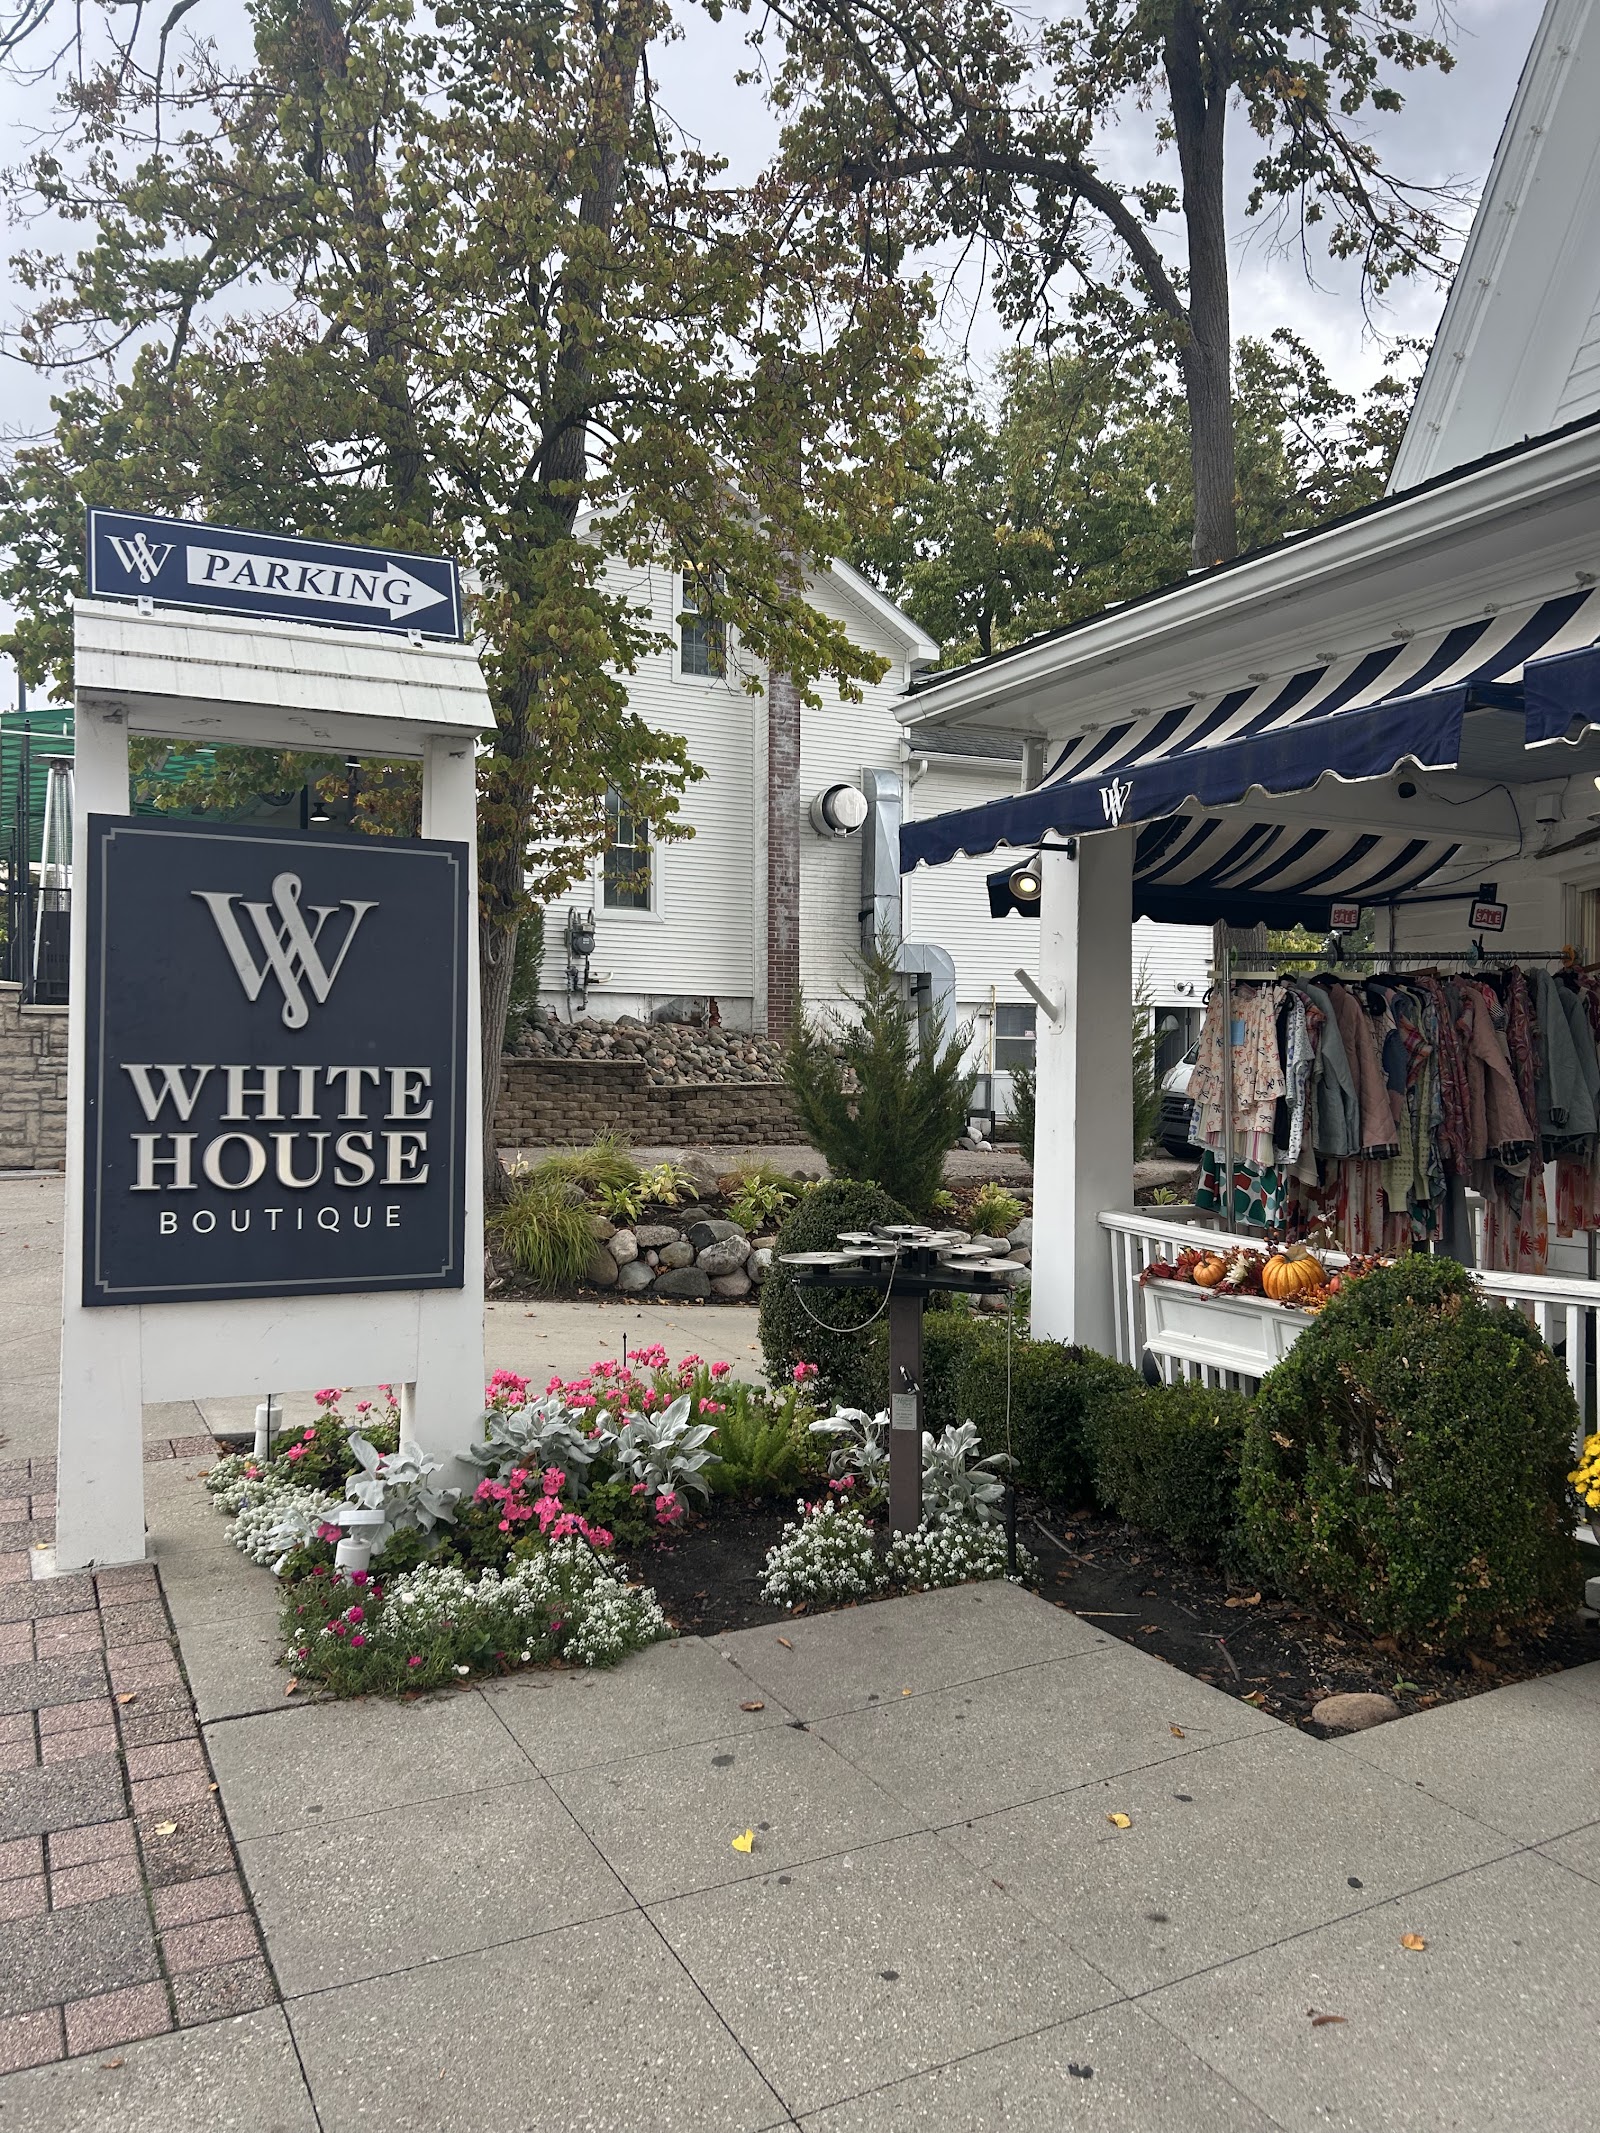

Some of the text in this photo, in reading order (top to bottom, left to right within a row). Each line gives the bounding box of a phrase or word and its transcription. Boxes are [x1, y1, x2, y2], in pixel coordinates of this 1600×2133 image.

[203, 554, 412, 605] PARKING
[1334, 913, 1356, 923] SALE
[1476, 913, 1501, 924] SALE
[120, 1063, 433, 1121] WHITE
[129, 1131, 430, 1190] HOUSE
[160, 1205, 401, 1235] BOUTIQUE
